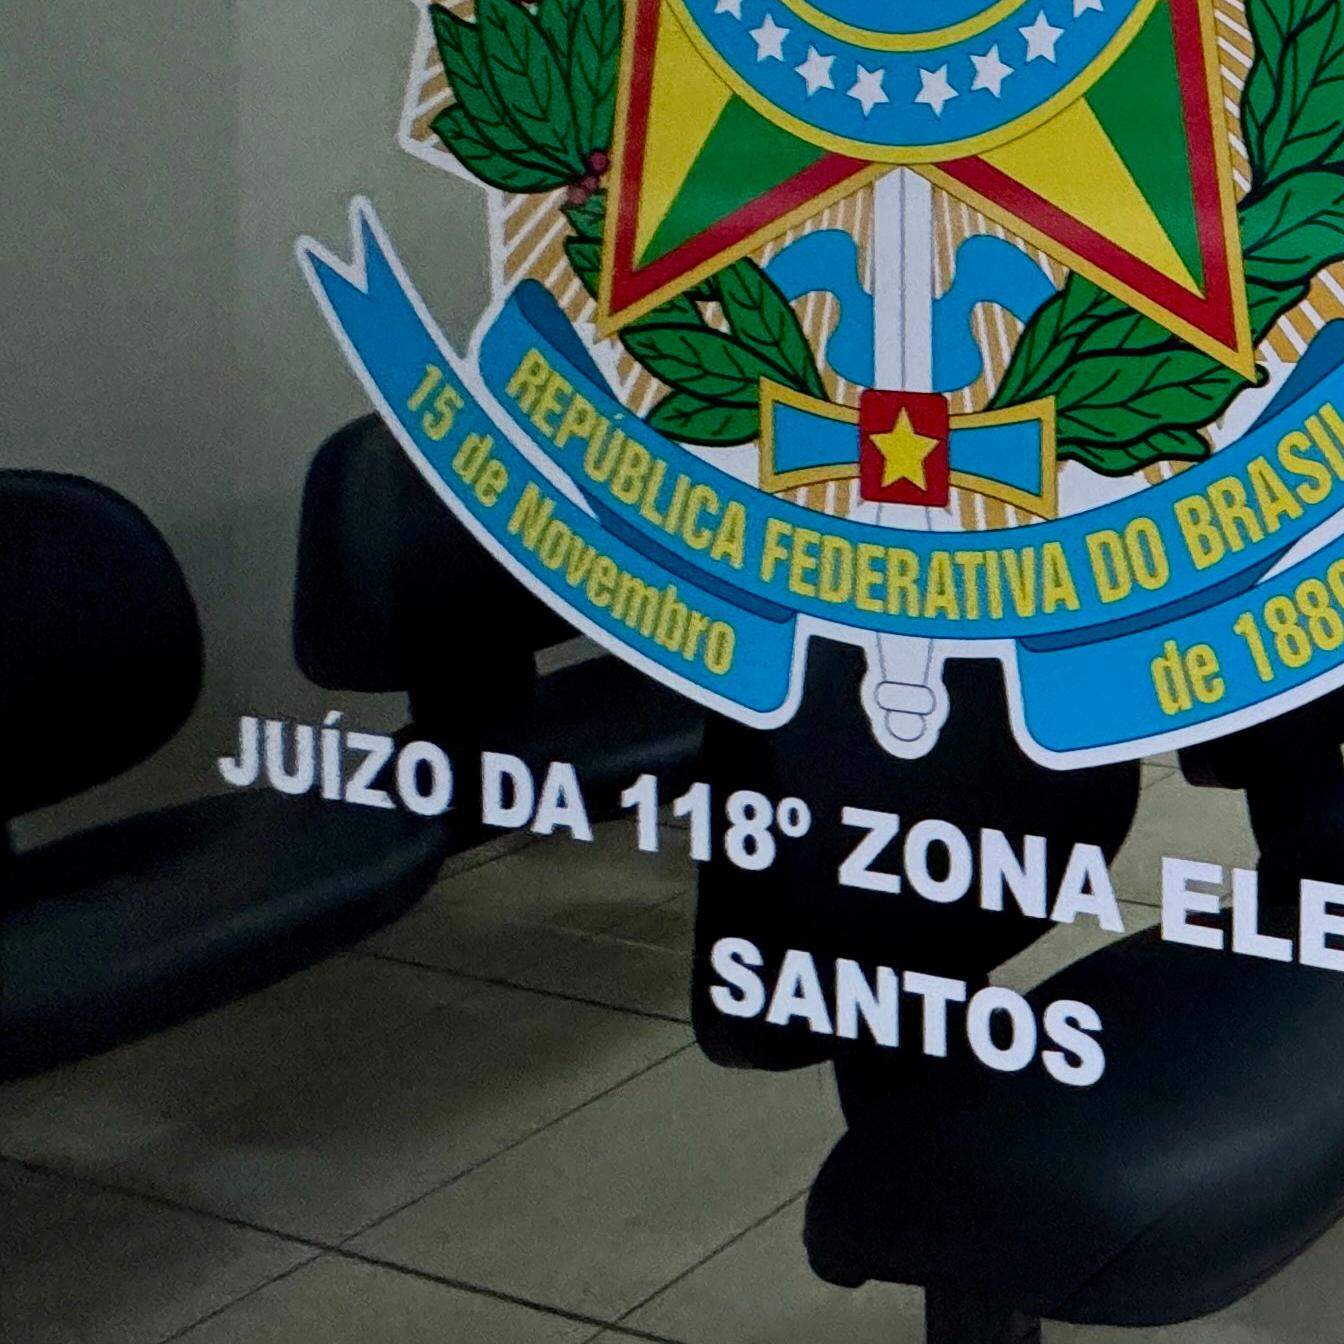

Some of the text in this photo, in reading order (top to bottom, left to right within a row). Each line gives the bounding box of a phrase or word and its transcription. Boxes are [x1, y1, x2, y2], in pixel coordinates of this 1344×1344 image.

[408, 364, 736, 675] 15 de Novembro
[760, 517, 1081, 620] FEDERATIVA
[1085, 517, 1169, 603] DO
[1151, 640, 1226, 715] de
[218, 710, 454, 816] JUÍZO
[481, 751, 593, 842] DA
[837, 806, 1124, 932] ZONA
[709, 938, 1106, 1087] SANTOS
